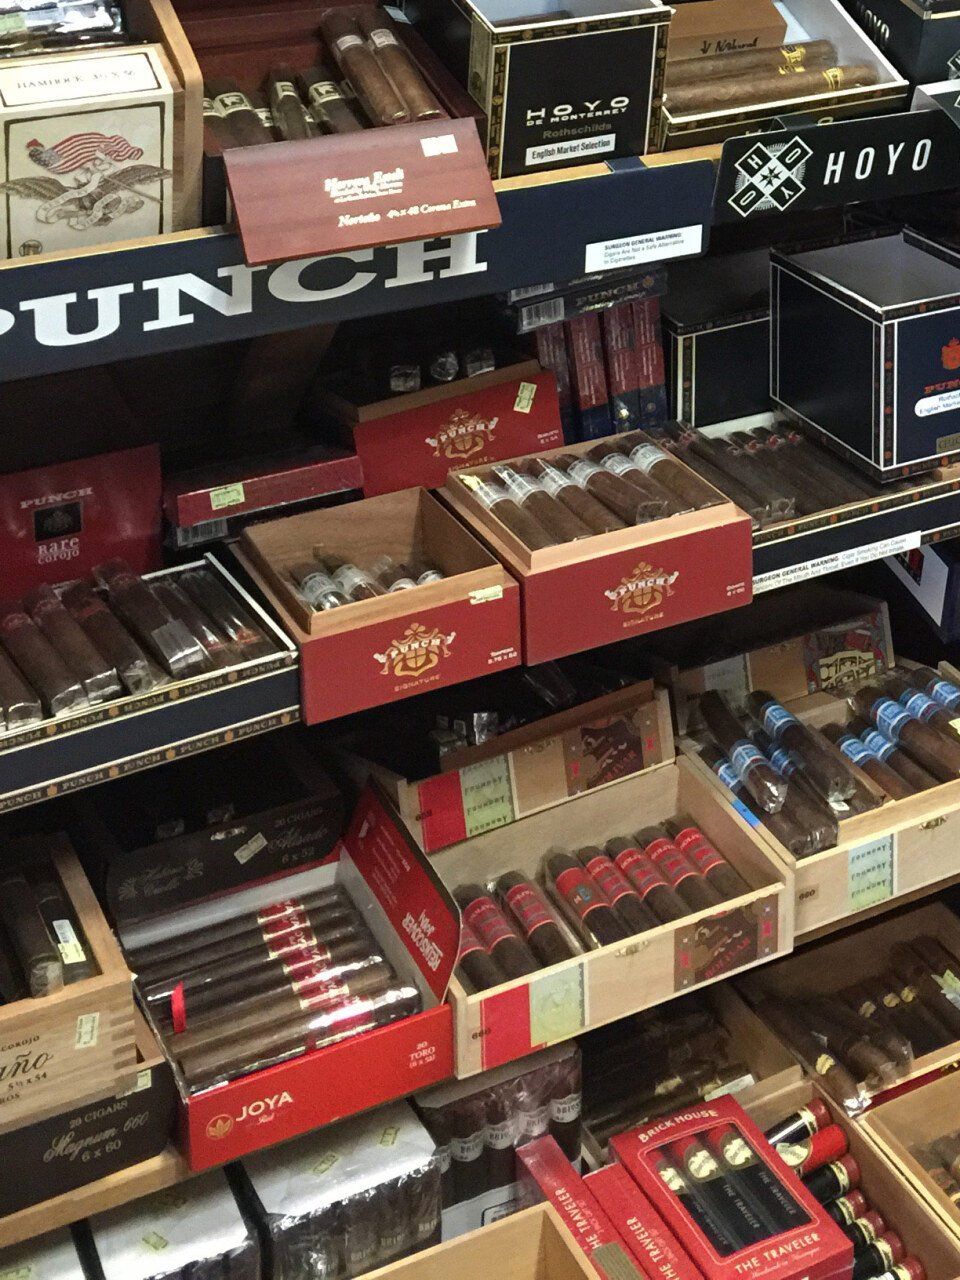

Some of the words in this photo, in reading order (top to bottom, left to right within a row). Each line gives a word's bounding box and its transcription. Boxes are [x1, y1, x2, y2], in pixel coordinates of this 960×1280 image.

[715, 37, 759, 52] Natural
[526, 96, 630, 121] HOYO
[526, 119, 543, 127] DE
[550, 107, 628, 124] MONTERREY
[542, 122, 612, 140] Rothschilds
[531, 147, 556, 160] English
[556, 143, 581, 156] Market
[580, 138, 611, 152] Selection
[823, 138, 934, 186] HOYO
[604, 240, 631, 251] SURGEON
[631, 236, 656, 247] GENERAL
[655, 232, 682, 243] WARNING
[575, 281, 641, 307] PUNCH
[440, 423, 486, 442] PUNCH
[20, 486, 94, 509] PUNCH
[38, 537, 80, 556] Rare
[37, 548, 80, 566] corojo
[752, 571, 781, 585] SURGEON
[781, 564, 810, 578] GENERAL
[810, 556, 840, 570] WARNING
[856, 543, 880, 558] Smoking
[793, 573, 811, 583] Mouth
[810, 569, 821, 579] And
[618, 577, 666, 597] PUNCH
[391, 638, 441, 659] PUNCH
[394, 674, 441, 692] SIGNATURE
[238, 719, 277, 735] PUNCH
[180, 736, 220, 754] PUNCH
[62, 772, 105, 790] PUNCH
[850, 844, 888, 863] FOUNDRY
[850, 861, 888, 880] FOUNDRY
[1, 1034, 41, 1052] COROJO
[408, 1045, 436, 1062] TORO
[35, 1072, 48, 1081] 54
[83, 1100, 129, 1123] CIGARS
[235, 1091, 294, 1122] JOYA
[637, 1119, 676, 1144] BRICK
[674, 1108, 720, 1127] HOUSE
[81, 1151, 91, 1163] 6
[105, 1139, 122, 1153] 60
[554, 1186, 591, 1233] TRAVELER
[626, 1216, 666, 1264] TRAVELER
[734, 1257, 761, 1275] THE
[763, 1232, 822, 1261] TRAVELER
